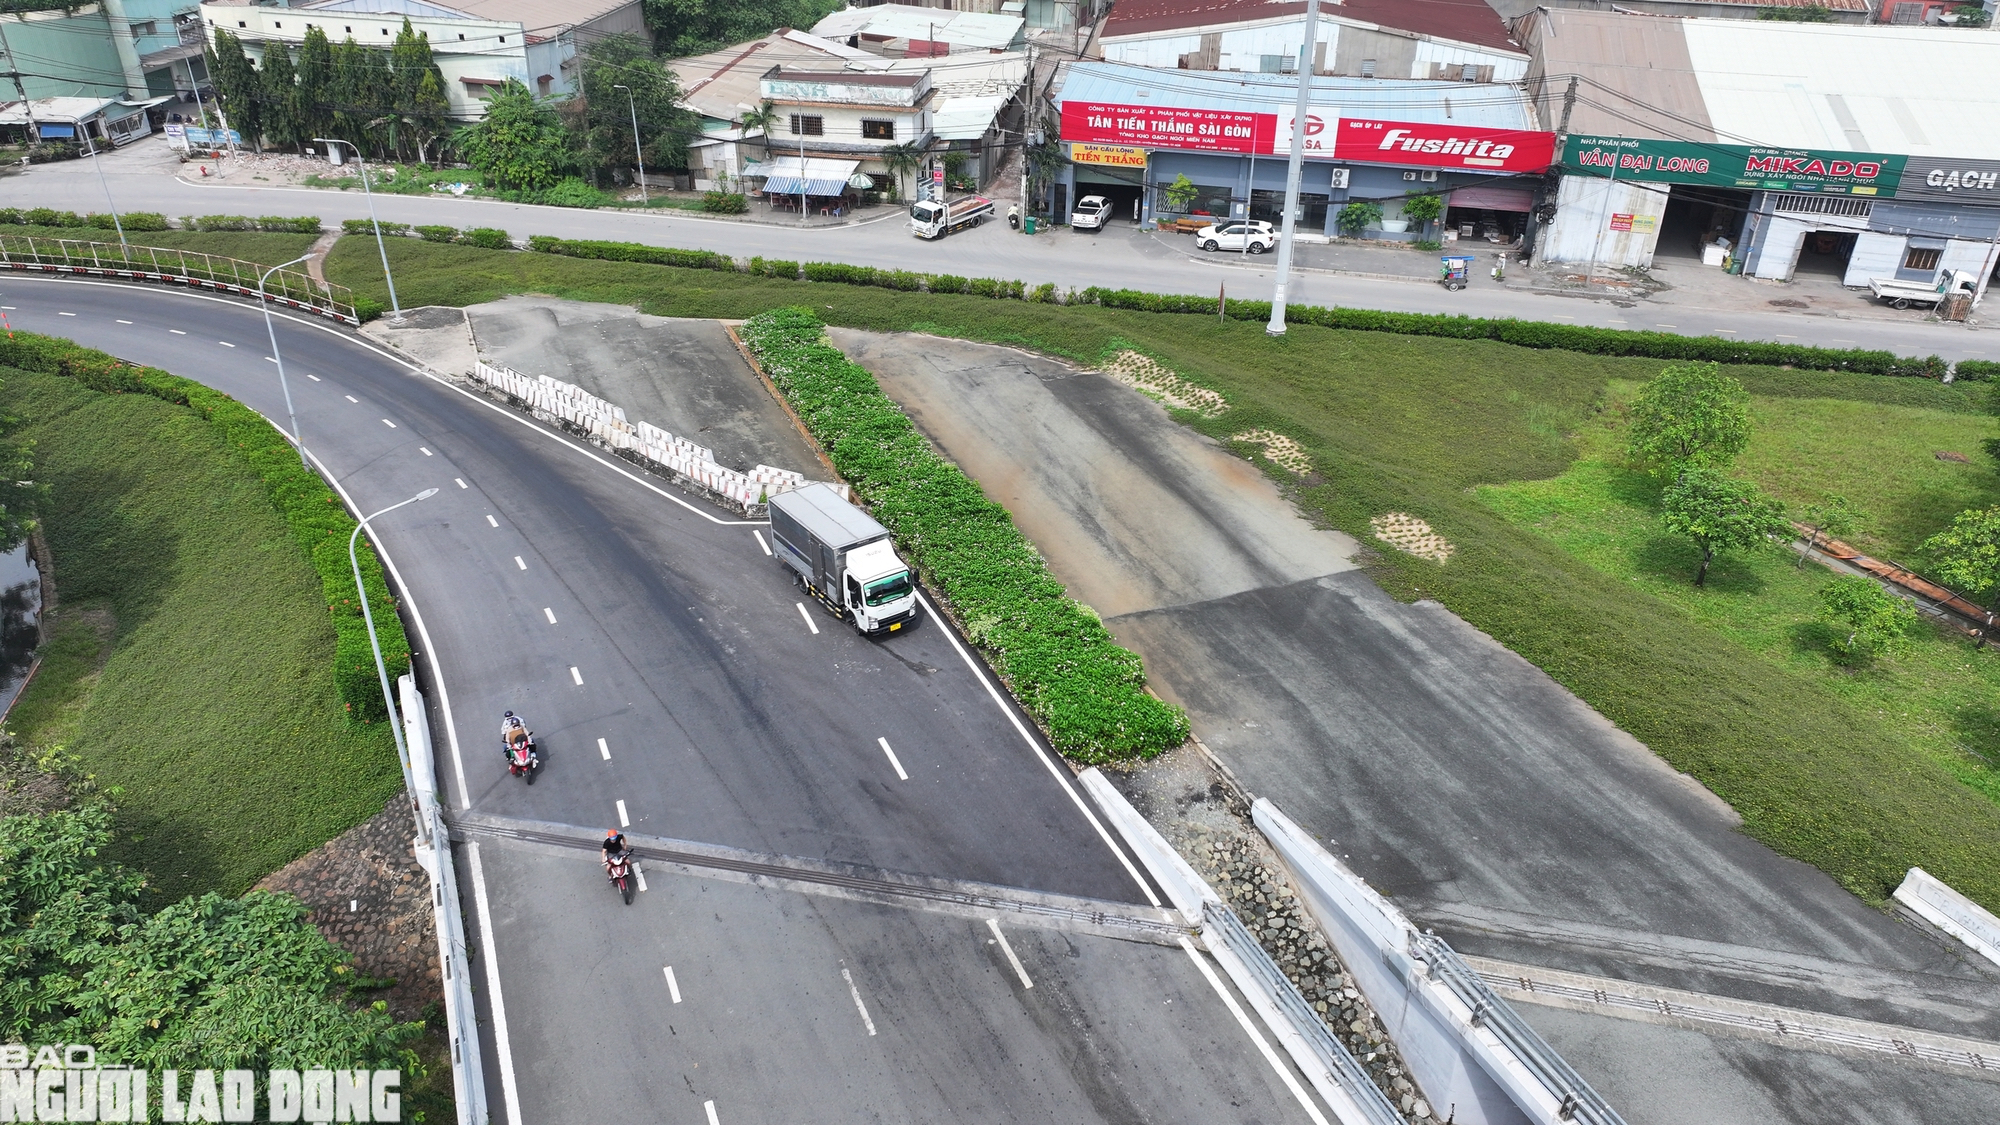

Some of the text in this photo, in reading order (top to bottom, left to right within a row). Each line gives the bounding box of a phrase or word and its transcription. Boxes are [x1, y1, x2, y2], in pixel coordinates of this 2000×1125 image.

[1087, 115, 1252, 138] TÂN TIẾN THẮNG SÀI GÒN
[1378, 129, 1515, 158] Fushita
[1621, 140, 1640, 148] PHỐI
[1074, 151, 1144, 165] TIẾN THẮNG
[1579, 148, 1709, 174] VÂN ĐẠI LONG
[1746, 155, 1880, 178] MIKADO
[1926, 169, 1998, 192] GẠCH
